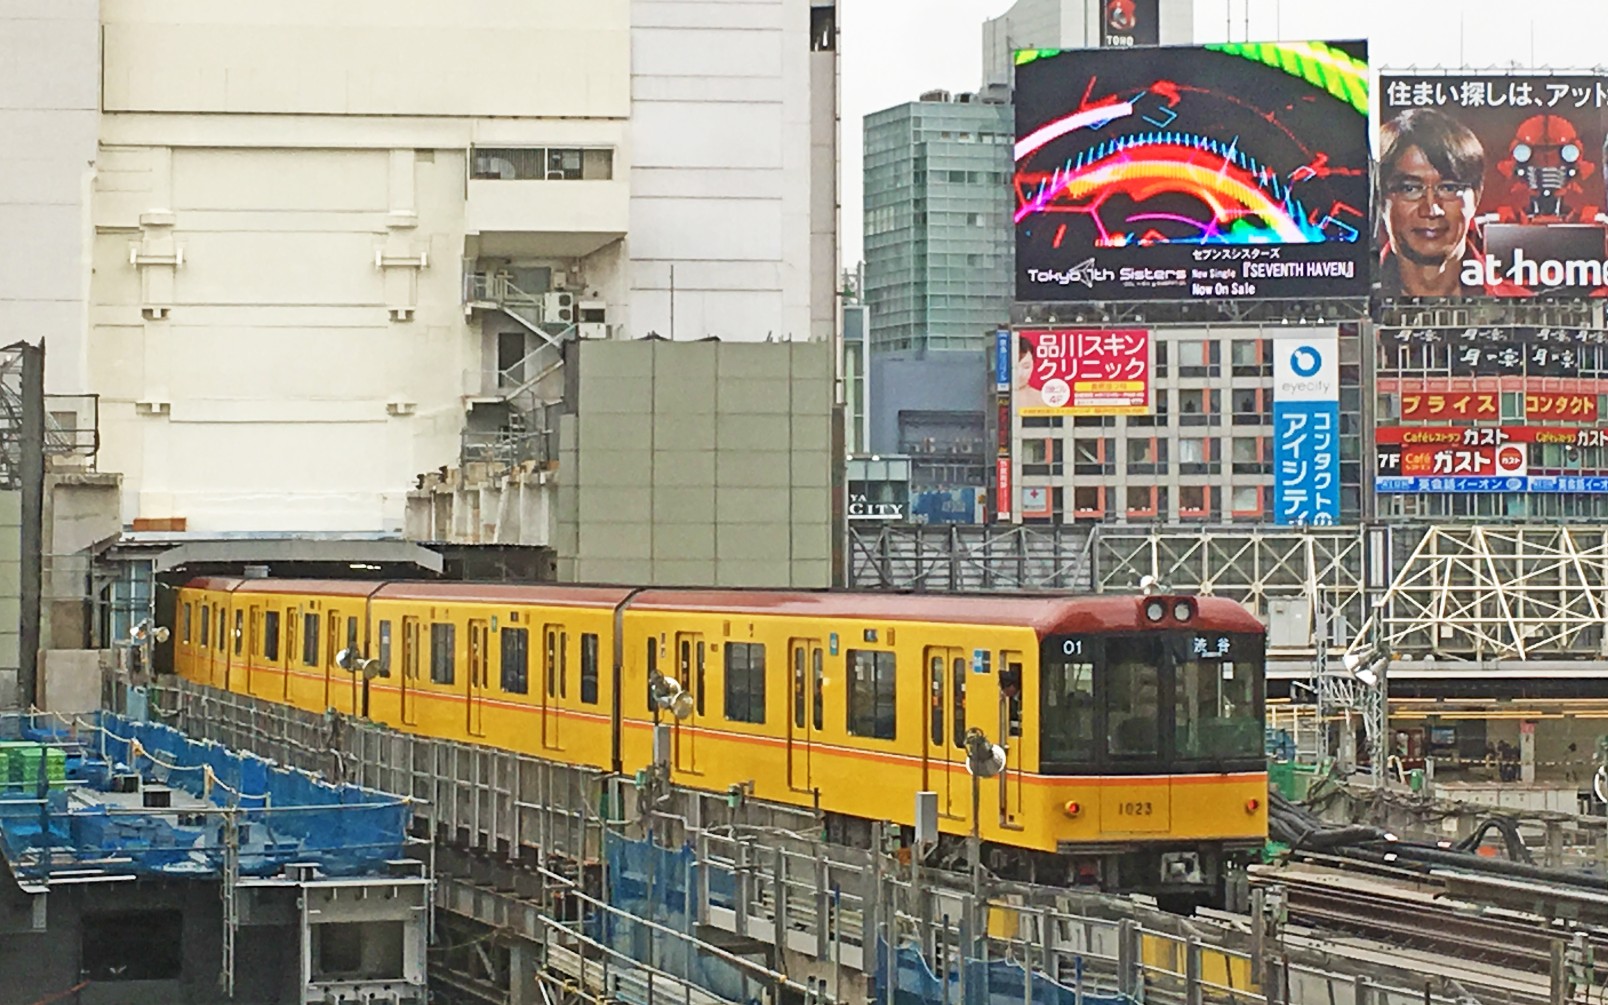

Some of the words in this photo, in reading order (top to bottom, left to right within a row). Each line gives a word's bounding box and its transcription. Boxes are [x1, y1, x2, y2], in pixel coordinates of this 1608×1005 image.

[1387, 81, 1608, 107] 住まい探しは、アット
[1192, 248, 1280, 260] セブンスシスターズ
[1028, 269, 1080, 285] Tokyo
[1119, 267, 1187, 281] Sisters
[1460, 254, 1503, 286] at
[1506, 248, 1608, 286] hom
[1192, 284, 1213, 295] Now
[1215, 283, 1229, 295] On
[1231, 282, 1256, 295] Sale
[1036, 333, 1145, 358] 品川スキン
[1037, 357, 1145, 380] クリニック
[1282, 381, 1330, 394] eyecity
[1403, 396, 1496, 414] プライス
[1526, 396, 1594, 415] コンタクト
[1378, 453, 1400, 468] 7F
[1433, 450, 1490, 474] ガスト
[849, 503, 903, 515] CITY
[1063, 640, 1082, 655] 01
[1118, 802, 1152, 815] 1023
